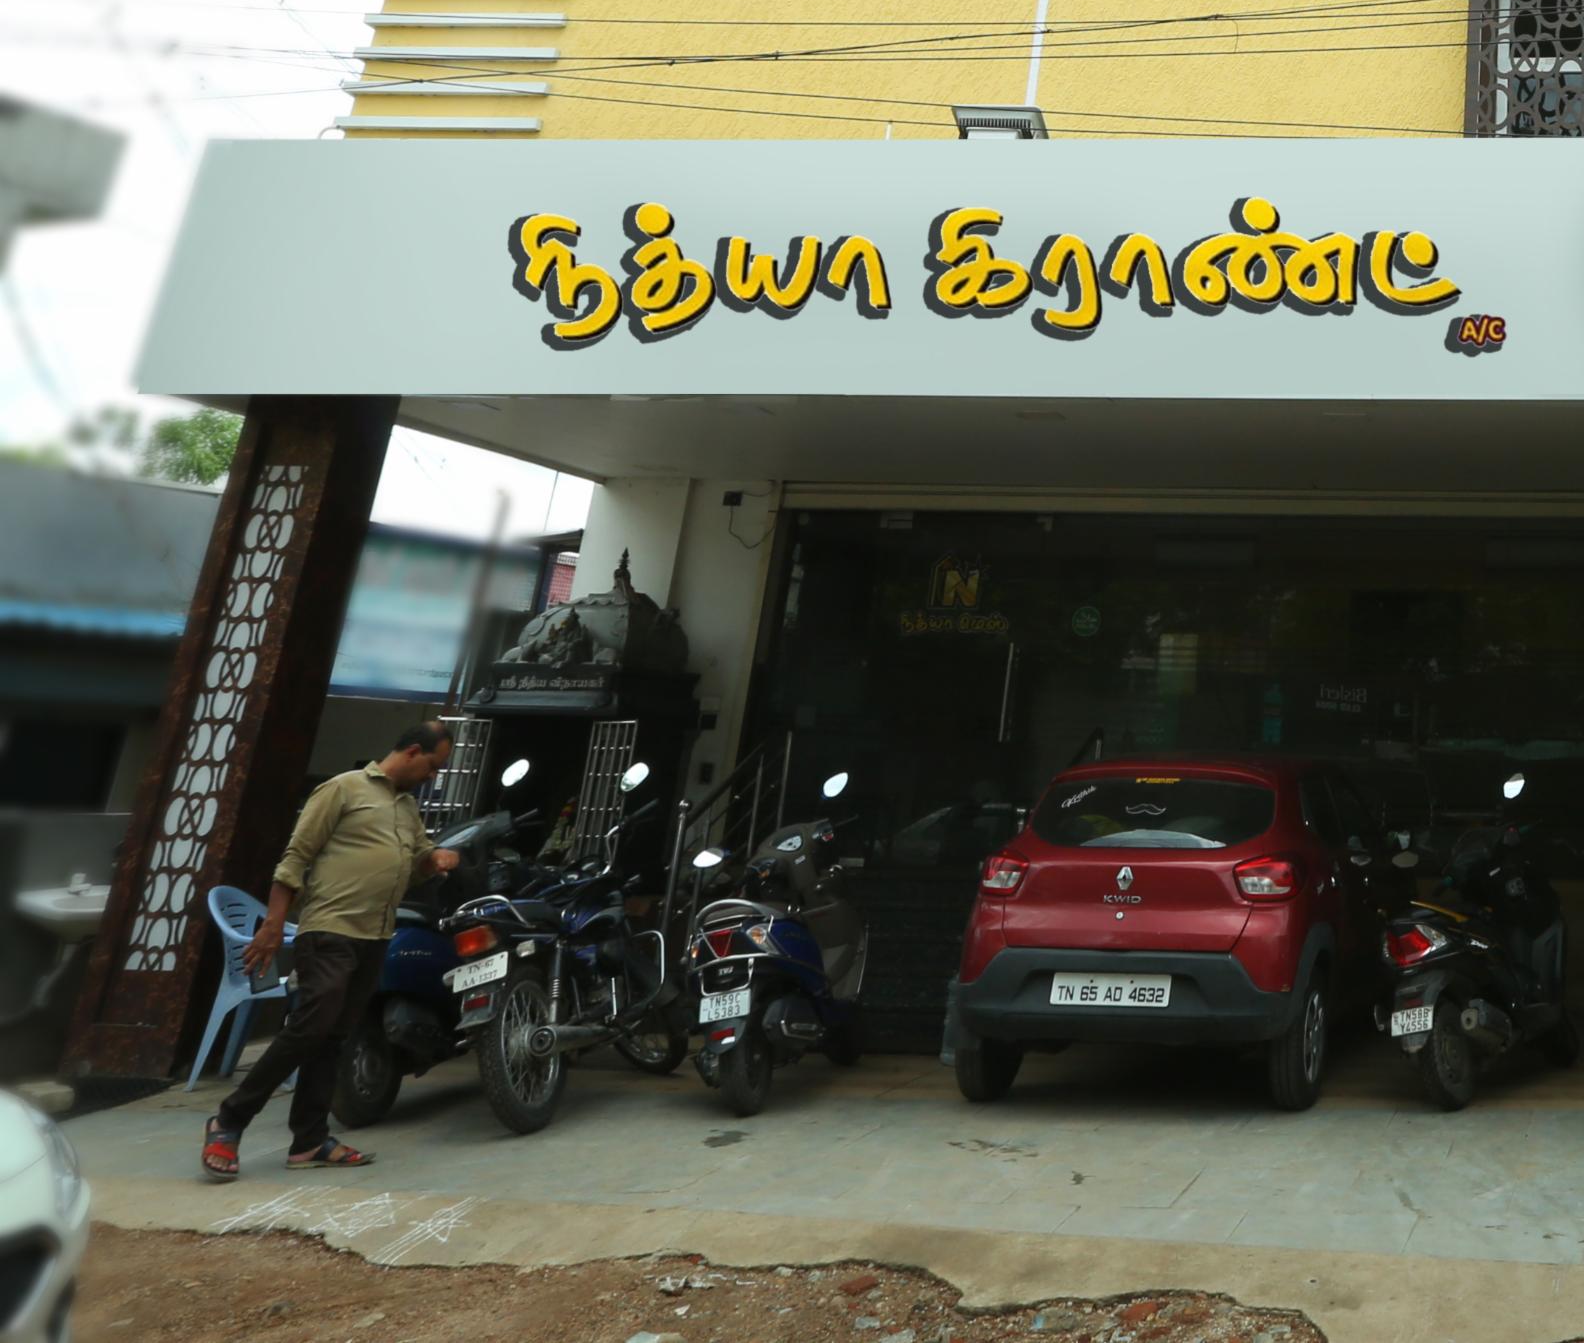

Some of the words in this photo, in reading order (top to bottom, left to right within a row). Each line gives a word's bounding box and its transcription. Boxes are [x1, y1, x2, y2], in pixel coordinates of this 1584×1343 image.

[519, 202, 892, 343] நித்யா
[936, 197, 1462, 330] கிராண்ட்
[1459, 314, 1507, 347] A/C
[1103, 895, 1142, 903] KWID
[1058, 985, 1075, 1001] TN
[1080, 986, 1098, 1001] 65
[1103, 987, 1123, 1002] AD
[1128, 987, 1165, 1003] 4632
